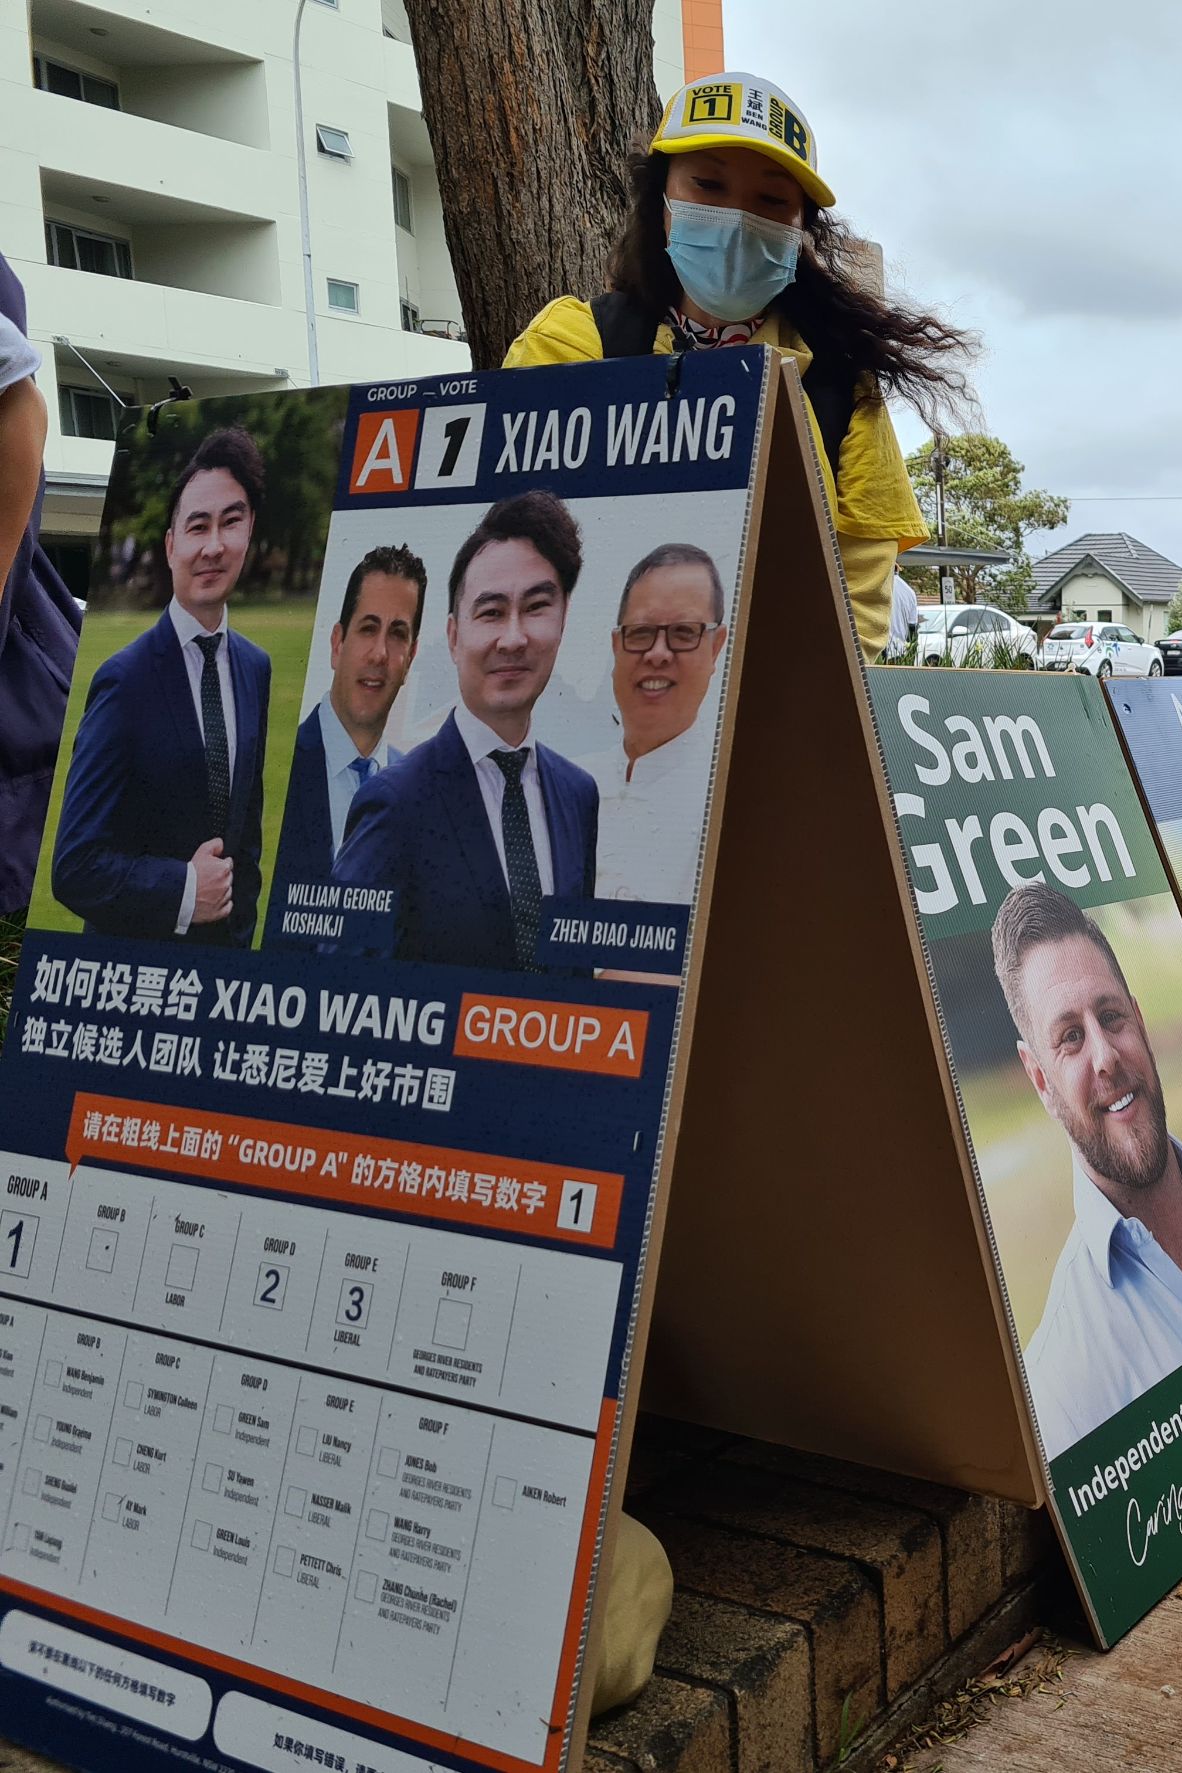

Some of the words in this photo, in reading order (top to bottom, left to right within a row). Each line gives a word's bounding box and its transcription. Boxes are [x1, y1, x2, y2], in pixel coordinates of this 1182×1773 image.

[692, 85, 731, 96] VOTE
[703, 98, 716, 116] 1
[745, 109, 764, 120] BEN
[741, 117, 767, 131] WANG
[769, 97, 783, 139] GROUP
[785, 108, 808, 161] B
[367, 384, 417, 401] GROUP
[439, 379, 478, 397] VOTE
[494, 405, 593, 475] XIAO
[605, 395, 736, 467] WANG
[356, 418, 407, 487] A
[437, 416, 472, 477] 1
[897, 693, 1056, 786] Sam
[893, 792, 1136, 914] Green
[287, 882, 338, 910] WILLIAM
[341, 886, 394, 914] GEORGE
[282, 914, 345, 939] KOSHAKJI
[550, 918, 591, 945] ZHEN
[593, 922, 627, 949] BIAO
[630, 925, 677, 952] JIANG
[30, 954, 204, 1022] 如何投票给
[208, 977, 307, 1030] XIAO
[318, 989, 447, 1047] WANG
[463, 1004, 602, 1055] GROUP
[608, 1020, 637, 1060] A
[21, 1015, 204, 1078] 独立候选人团队
[211, 1041, 457, 1112] 让悉尼爱上好市围
[82, 1109, 224, 1162] 请在粗线上面的
[352, 1155, 548, 1216] 的方格内填写数字
[7, 1175, 39, 1198] GROUP
[40, 1181, 48, 1201] A
[97, 1204, 119, 1220] GROUP
[120, 1208, 126, 1222] B
[568, 1187, 587, 1225] 1
[174, 1219, 198, 1236] GROUP
[8, 1219, 24, 1268] 1
[263, 1237, 288, 1254] GROUP
[288, 1242, 296, 1256] D
[344, 1252, 371, 1271] GROUP
[372, 1257, 379, 1273] E
[260, 1268, 281, 1304] 2
[441, 1271, 469, 1290] GROUP
[469, 1276, 477, 1292] F
[165, 1291, 186, 1308] LABOR
[344, 1286, 365, 1321] 3
[77, 1332, 96, 1348] GROUP
[333, 1329, 361, 1347] LIBERAL
[155, 1352, 175, 1368] GROUP
[413, 1348, 436, 1364] GEORGES
[436, 1353, 453, 1367] RIVER
[453, 1356, 483, 1374] RESIDENTS
[241, 1373, 262, 1389] GROUP
[413, 1364, 425, 1375] AND
[426, 1366, 458, 1384] RATEPAYERS
[458, 1373, 477, 1388] PARTY
[147, 1387, 177, 1405] SYMINGTON
[326, 1394, 349, 1411] GROUP
[349, 1400, 355, 1413] E
[144, 1404, 161, 1418] LABOR
[238, 1411, 256, 1426] GREEN
[257, 1416, 270, 1430] Sam
[418, 1416, 442, 1433] GROUP
[442, 1422, 449, 1435] F
[235, 1429, 270, 1448] Independent
[322, 1433, 332, 1446] LIU
[333, 1436, 352, 1453] Nancy
[133, 1460, 151, 1475] LABOR
[319, 1451, 342, 1467] LIBERAL
[404, 1454, 424, 1470] JONES
[424, 1460, 437, 1473] Bob
[227, 1469, 236, 1481] SU
[236, 1471, 254, 1487] Yawen
[224, 1487, 259, 1507] Independent
[311, 1493, 334, 1509] NASSER
[522, 1485, 542, 1501] AIKEN
[542, 1490, 567, 1508] Robert
[307, 1511, 331, 1528] LIBERAL
[394, 1517, 413, 1532] WANG
[413, 1522, 431, 1538] Harry
[216, 1528, 235, 1543] GREEN
[234, 1533, 250, 1548] Louis
[213, 1546, 248, 1566] Independent
[300, 1553, 326, 1572] PETTETT
[325, 1559, 342, 1577] Chris
[296, 1571, 320, 1589] LIBERAL
[382, 1579, 404, 1596] ZHANG
